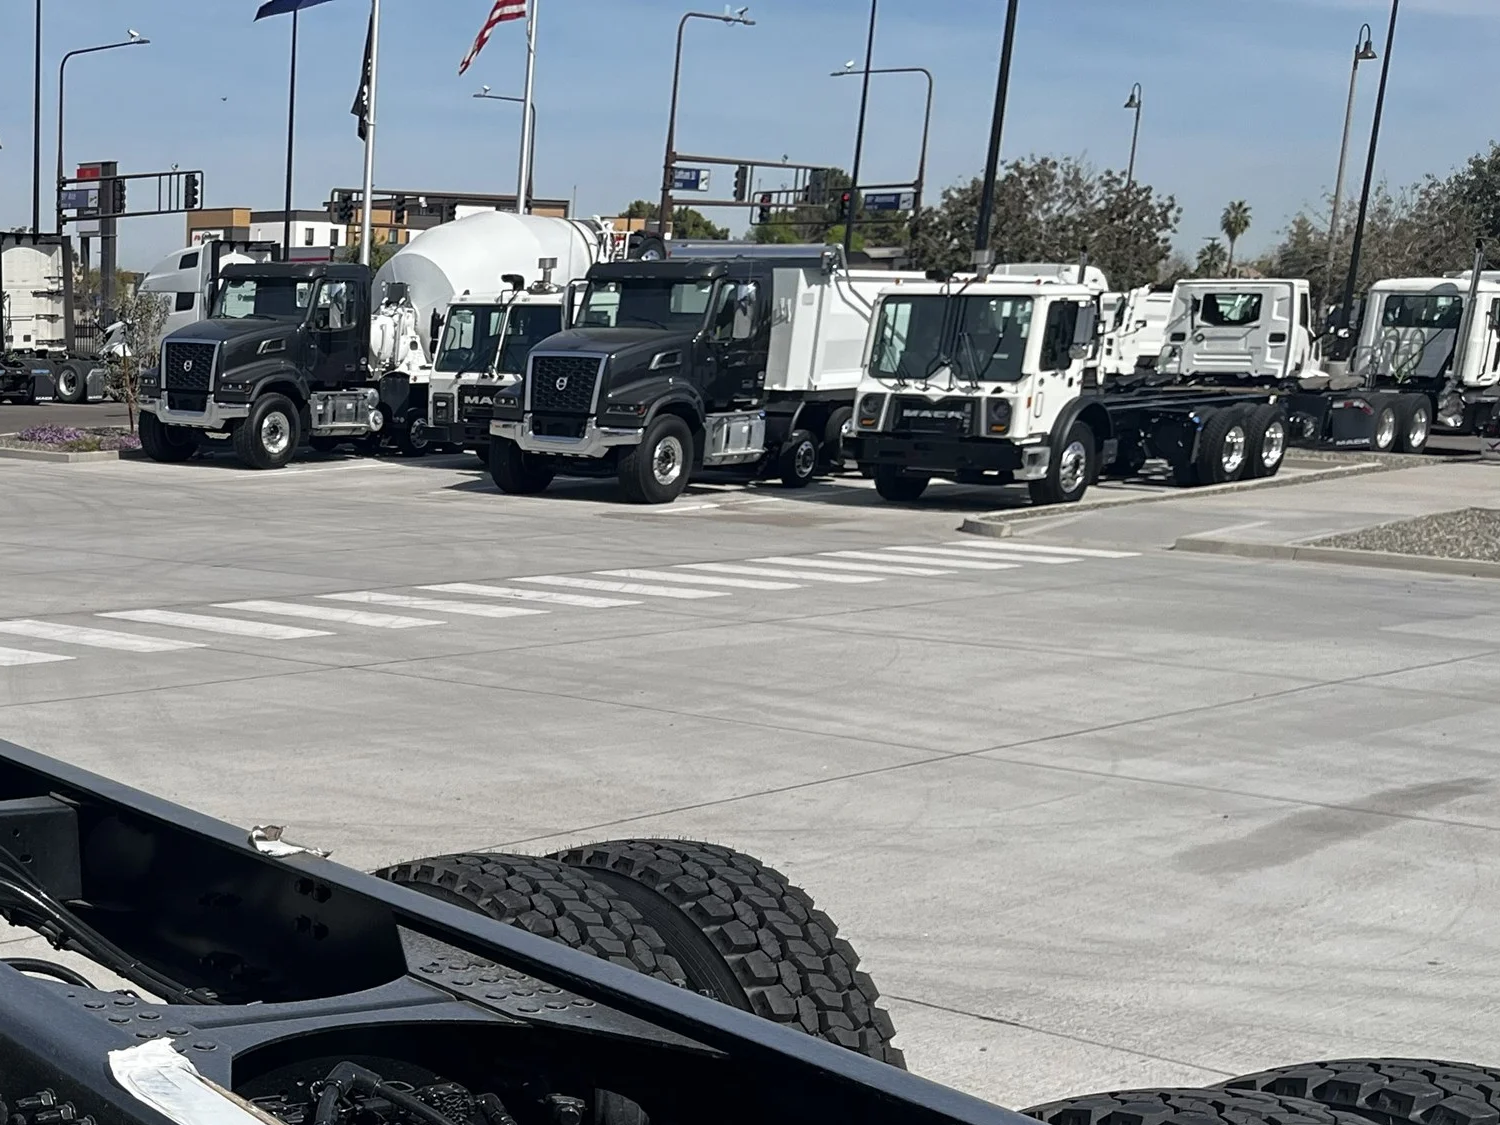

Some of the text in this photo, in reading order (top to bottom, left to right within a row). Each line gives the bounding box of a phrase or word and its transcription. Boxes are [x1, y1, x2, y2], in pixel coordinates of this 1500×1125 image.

[464, 396, 493, 404] MA
[903, 409, 963, 419] MACK
[1336, 437, 1371, 446] MACK
